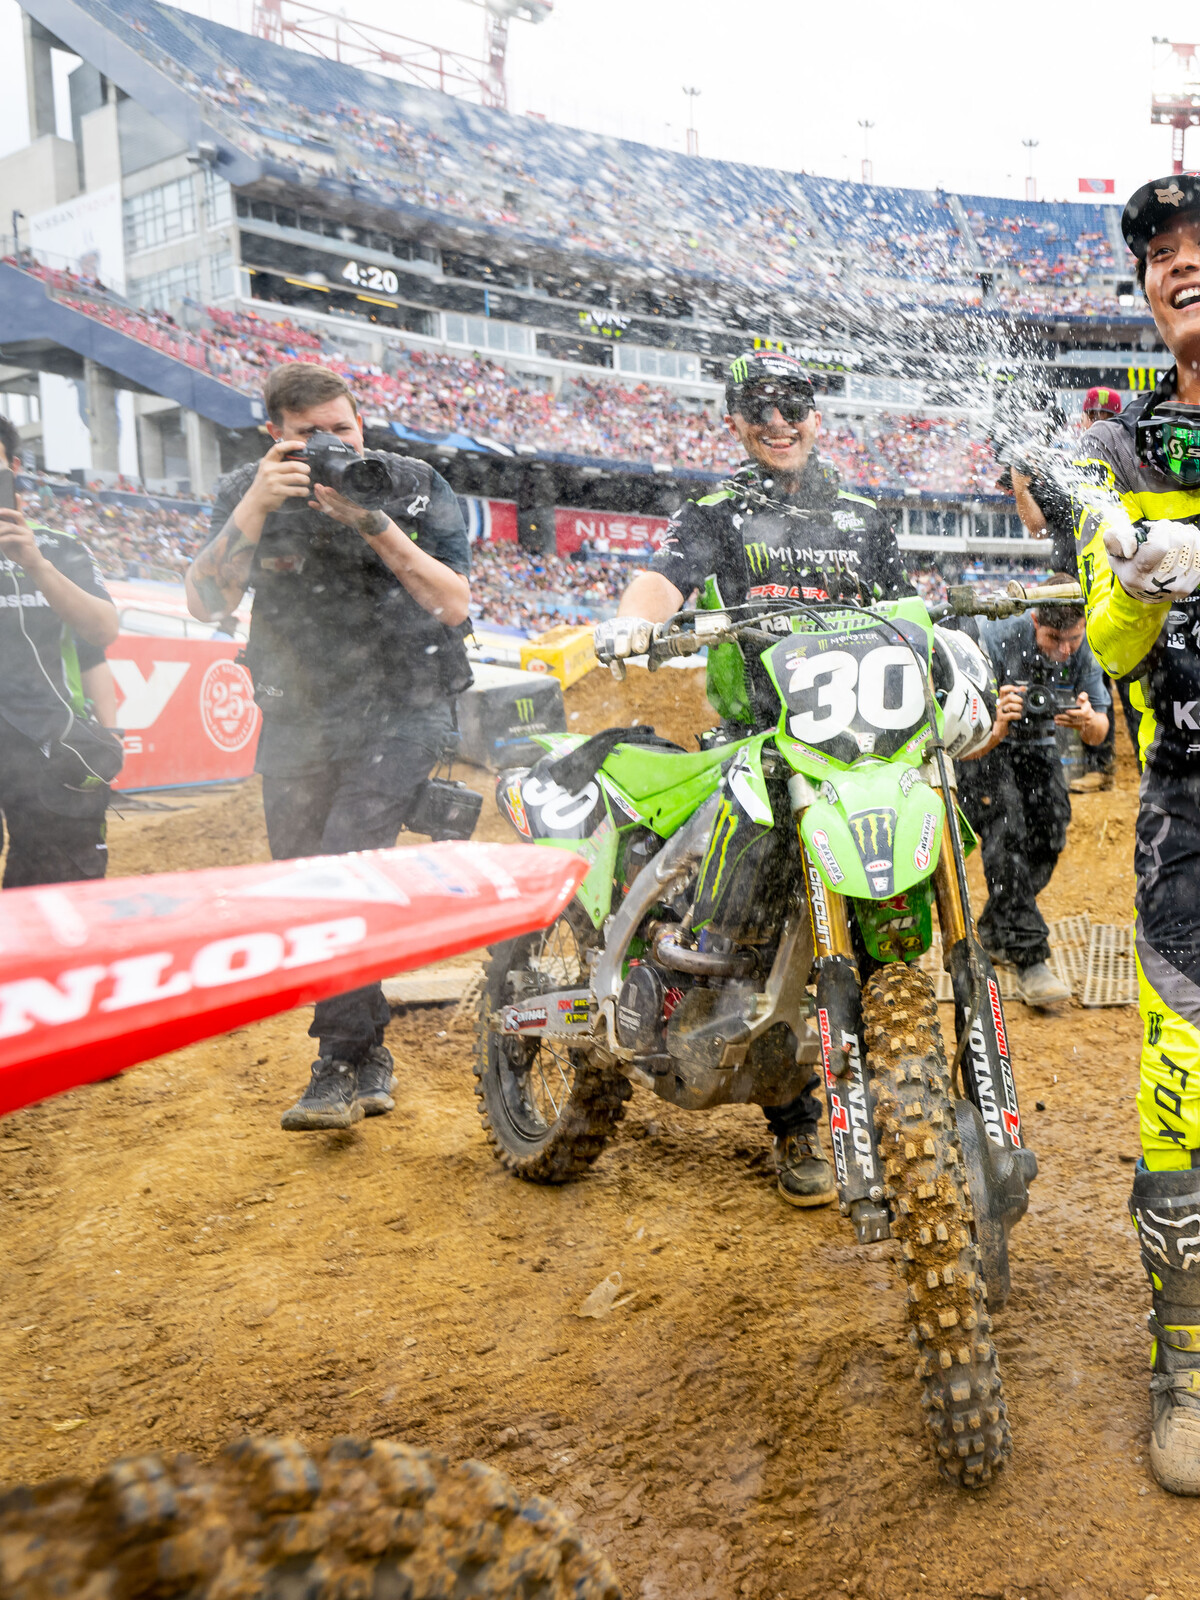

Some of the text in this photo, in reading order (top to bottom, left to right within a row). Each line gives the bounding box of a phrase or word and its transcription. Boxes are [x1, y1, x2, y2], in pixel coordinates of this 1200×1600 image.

[341, 261, 400, 294] 4:20
[575, 518, 670, 545] NISSA
[768, 546, 861, 565] MONSTER
[1172, 595, 1200, 604] NLOP
[212, 681, 245, 719] 25
[788, 645, 928, 745] 30
[522, 777, 600, 830] 30
[808, 867, 832, 950] CIRCUIT
[0, 916, 368, 1039] NLOP
[987, 977, 1008, 1058] BRAKING
[1154, 1052, 1190, 1150] FOX
